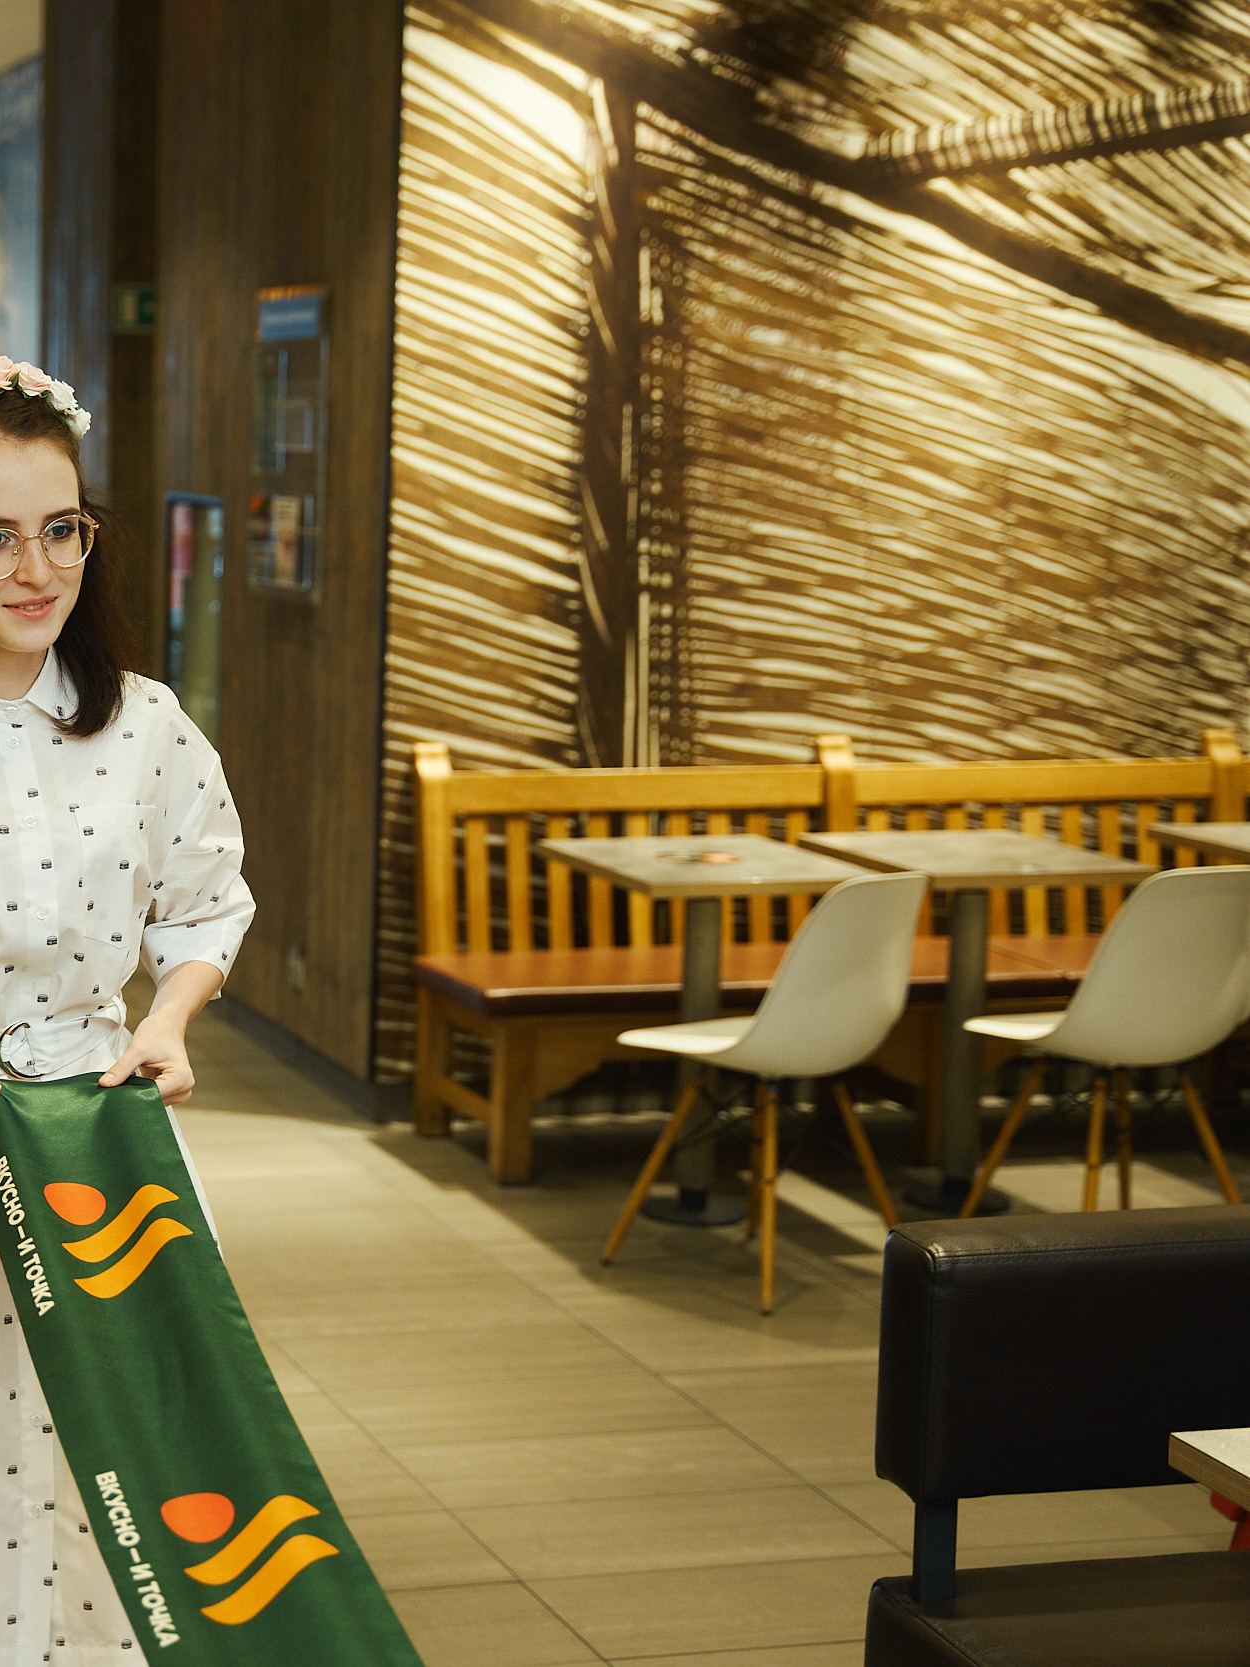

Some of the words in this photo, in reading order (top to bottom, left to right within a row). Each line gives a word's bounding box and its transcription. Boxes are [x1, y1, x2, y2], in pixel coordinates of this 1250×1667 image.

[17, 1237, 36, 1257] И
[23, 1253, 55, 1317] ТОЧКА
[95, 1470, 141, 1548] ВКУСНО
[130, 1562, 155, 1582] И
[138, 1579, 181, 1648] ТОЧКА
